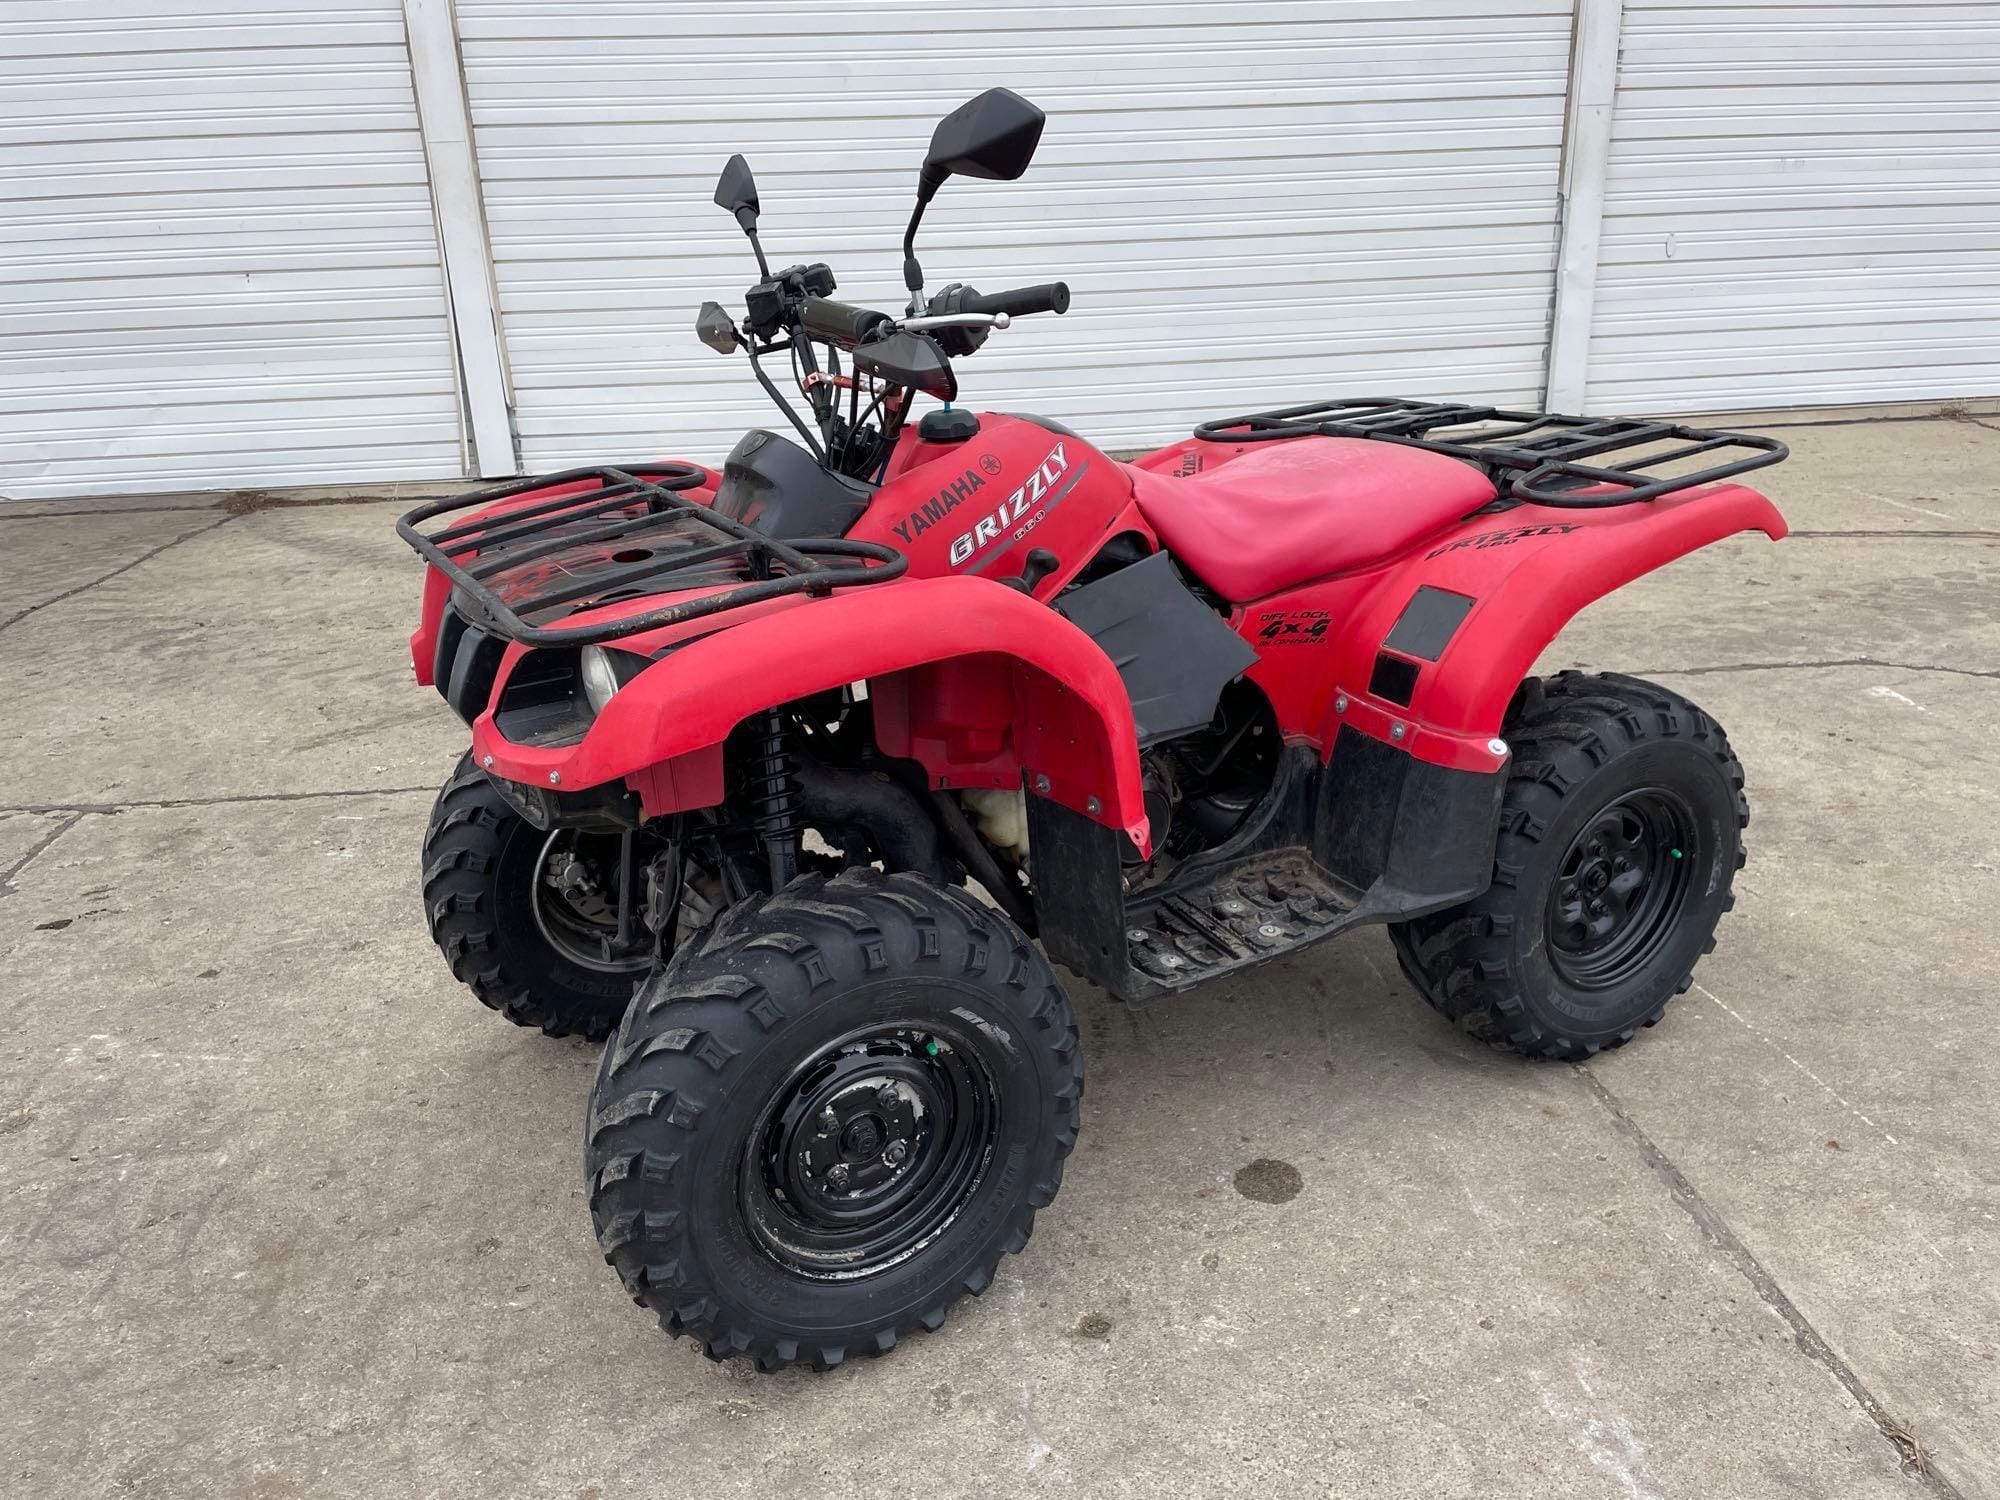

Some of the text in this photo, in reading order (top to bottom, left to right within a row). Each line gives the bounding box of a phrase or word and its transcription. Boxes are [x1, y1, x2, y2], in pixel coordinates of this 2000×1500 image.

[891, 470, 986, 544] YAMAHA
[949, 440, 1069, 567] GRIZZLY
[1014, 509, 1046, 541] 660
[1423, 525, 1585, 562] GRIZZLY
[1259, 611, 1329, 621] DIFF LOCK
